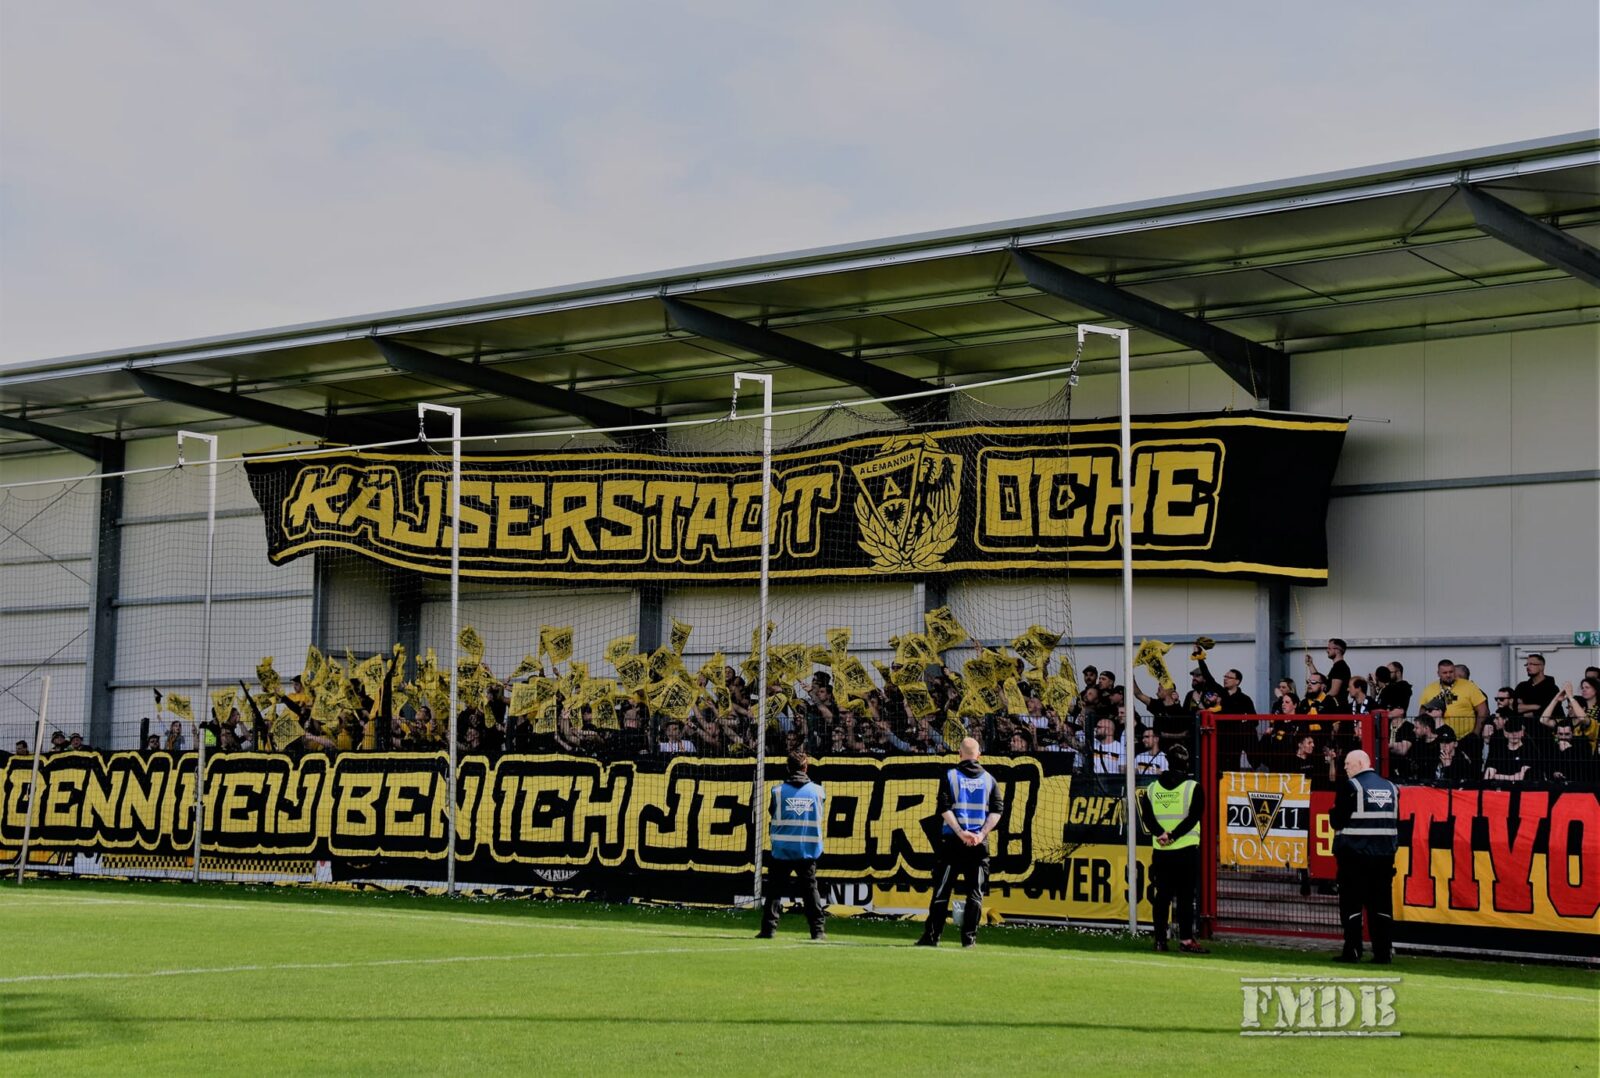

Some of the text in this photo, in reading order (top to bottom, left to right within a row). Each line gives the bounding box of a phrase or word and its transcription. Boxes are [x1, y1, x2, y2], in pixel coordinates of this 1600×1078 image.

[860, 453, 915, 475] ALEMANNIA
[984, 450, 1215, 537] OCHE
[6, 768, 164, 830] DENN
[335, 772, 481, 840] BEN
[499, 775, 628, 844] ICH
[644, 777, 1032, 857] JEOR!
[1228, 806, 1300, 829] 20 11
[1231, 838, 1305, 865] JONGE
[1398, 785, 1600, 917] TIVO
